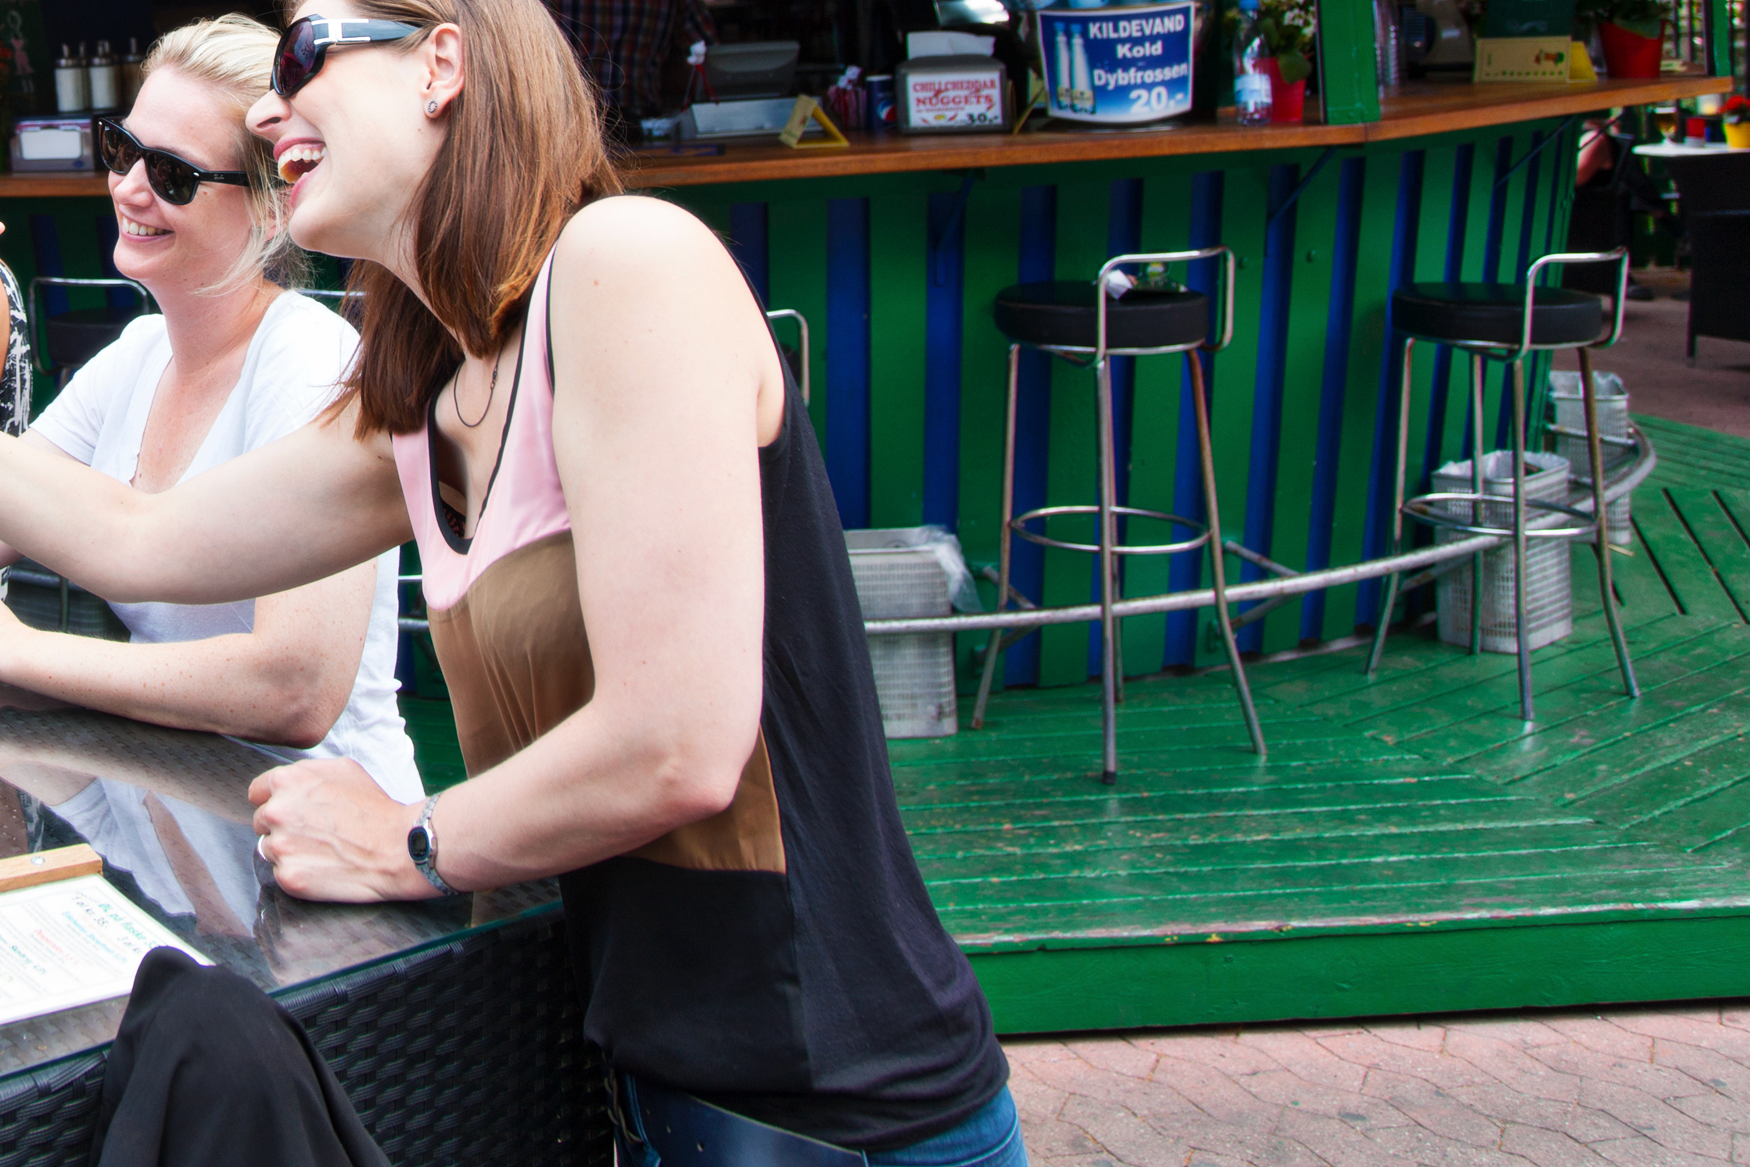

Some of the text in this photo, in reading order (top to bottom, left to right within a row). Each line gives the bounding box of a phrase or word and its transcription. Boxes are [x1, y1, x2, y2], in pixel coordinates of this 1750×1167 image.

[1088, 14, 1186, 40] KILDEVAND
[1116, 40, 1163, 59] Kold
[1092, 63, 1189, 91] Dybfrossen
[916, 94, 993, 107] NUGGETS
